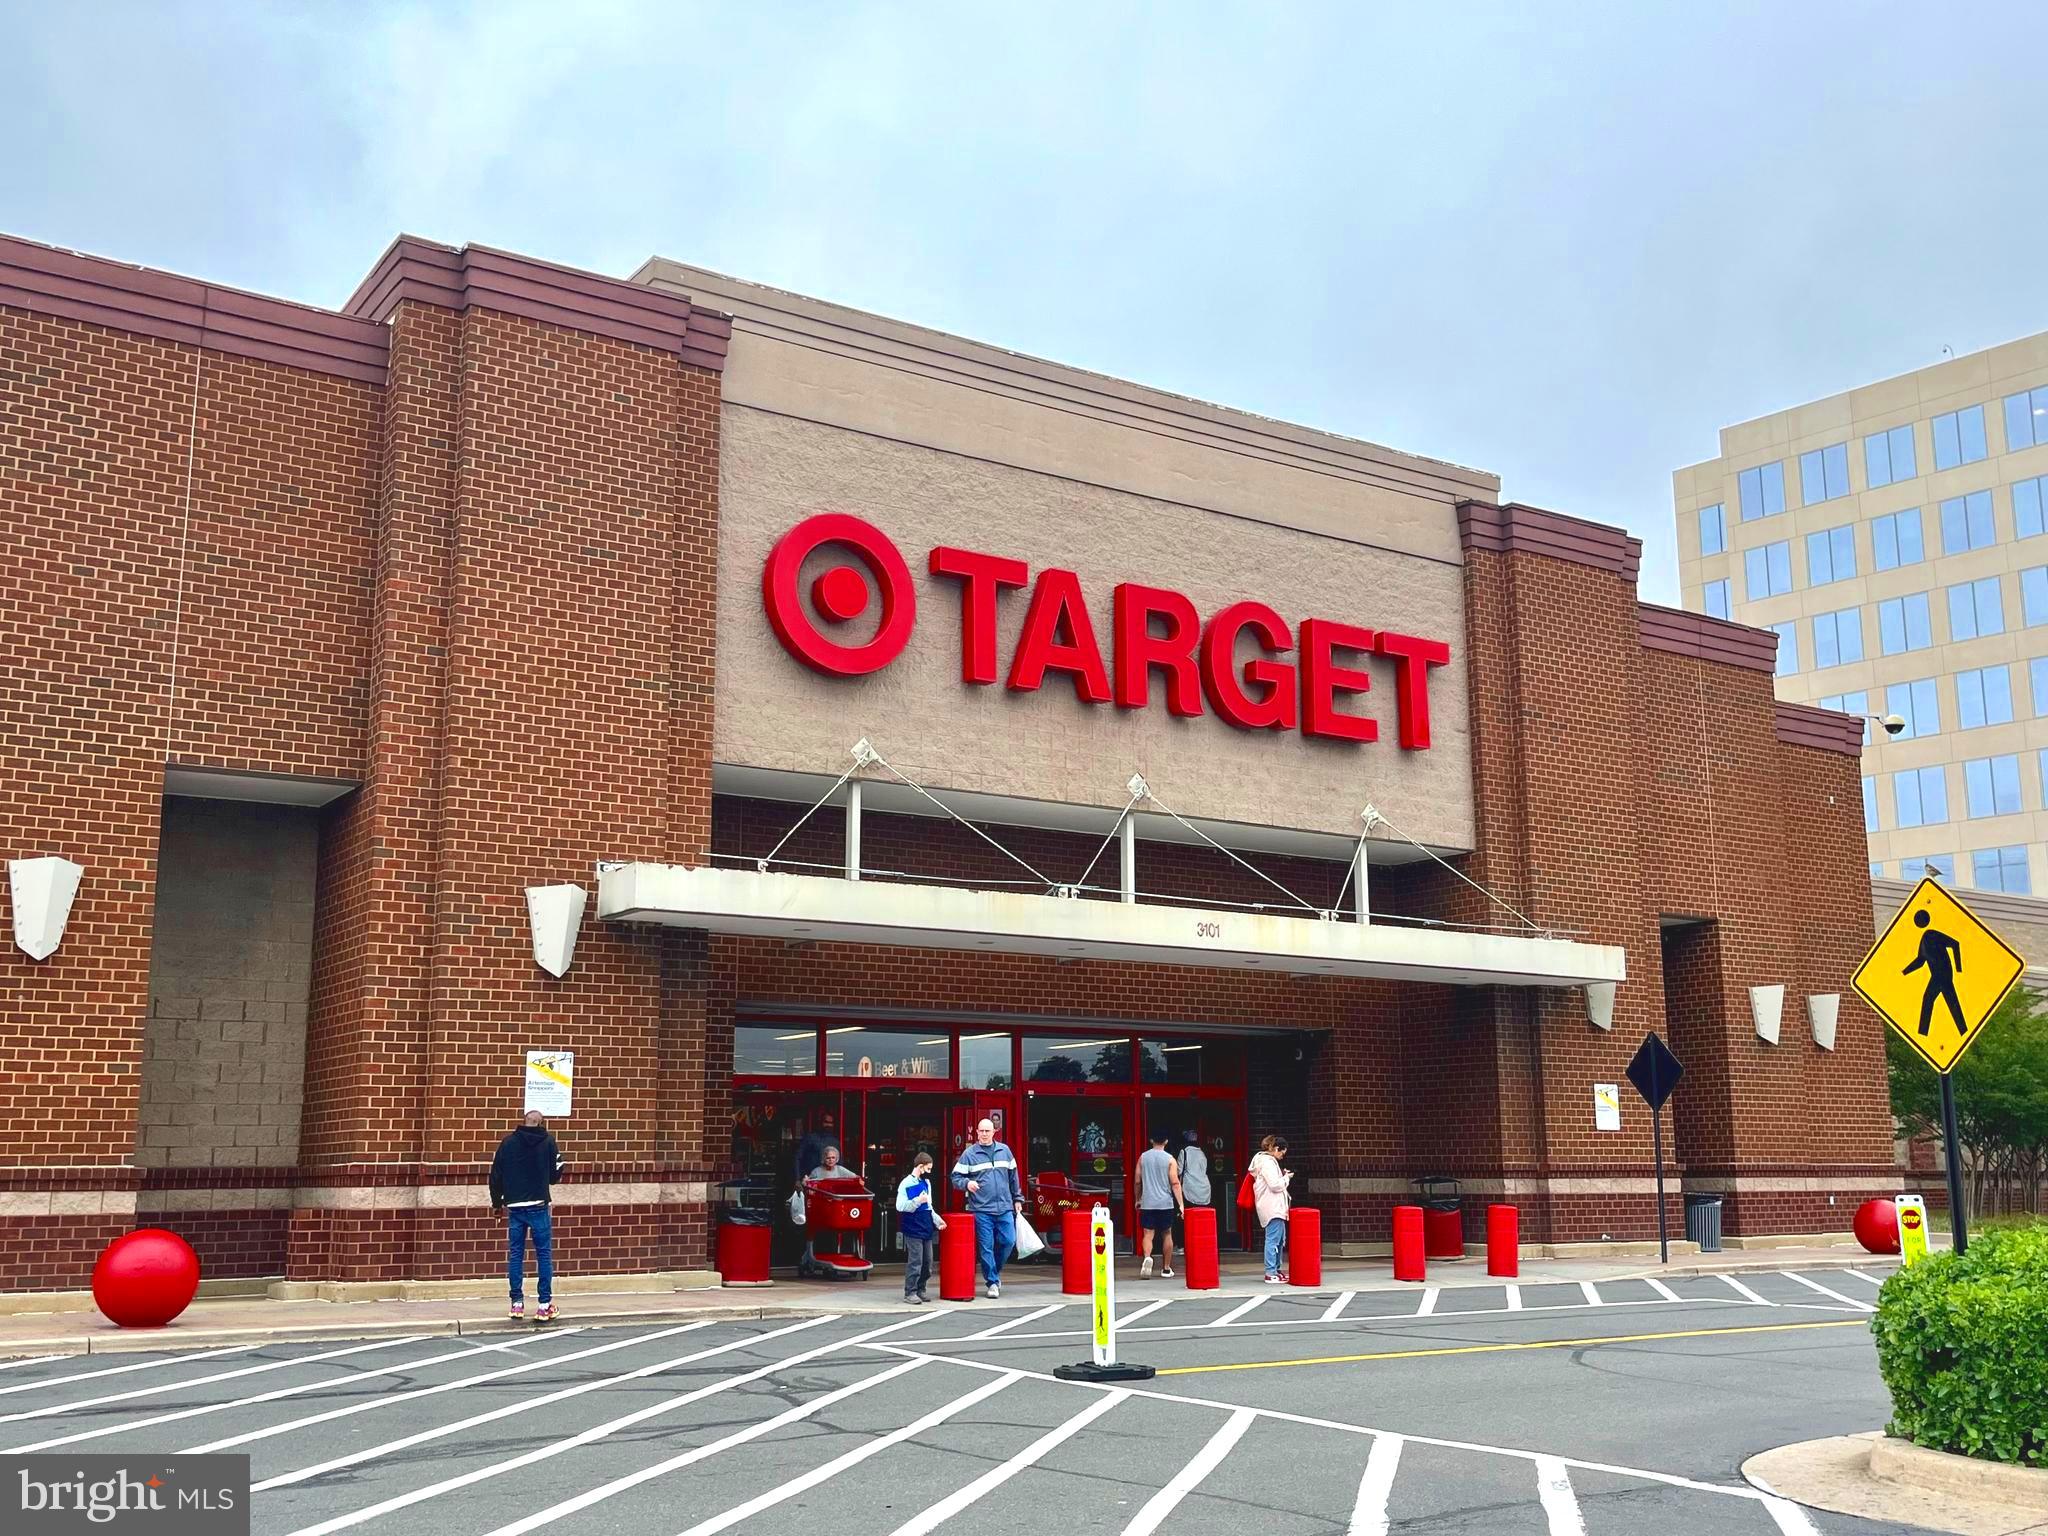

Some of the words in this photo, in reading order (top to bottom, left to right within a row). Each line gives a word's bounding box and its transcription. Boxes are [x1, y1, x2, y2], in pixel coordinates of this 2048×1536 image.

[929, 546, 1450, 751] TARGET
[1196, 922, 1220, 938] 3101
[875, 1061, 898, 1077] Beer
[901, 1058, 909, 1075] &
[911, 1056, 938, 1074] Wine
[1902, 1215, 1920, 1224] STOP
